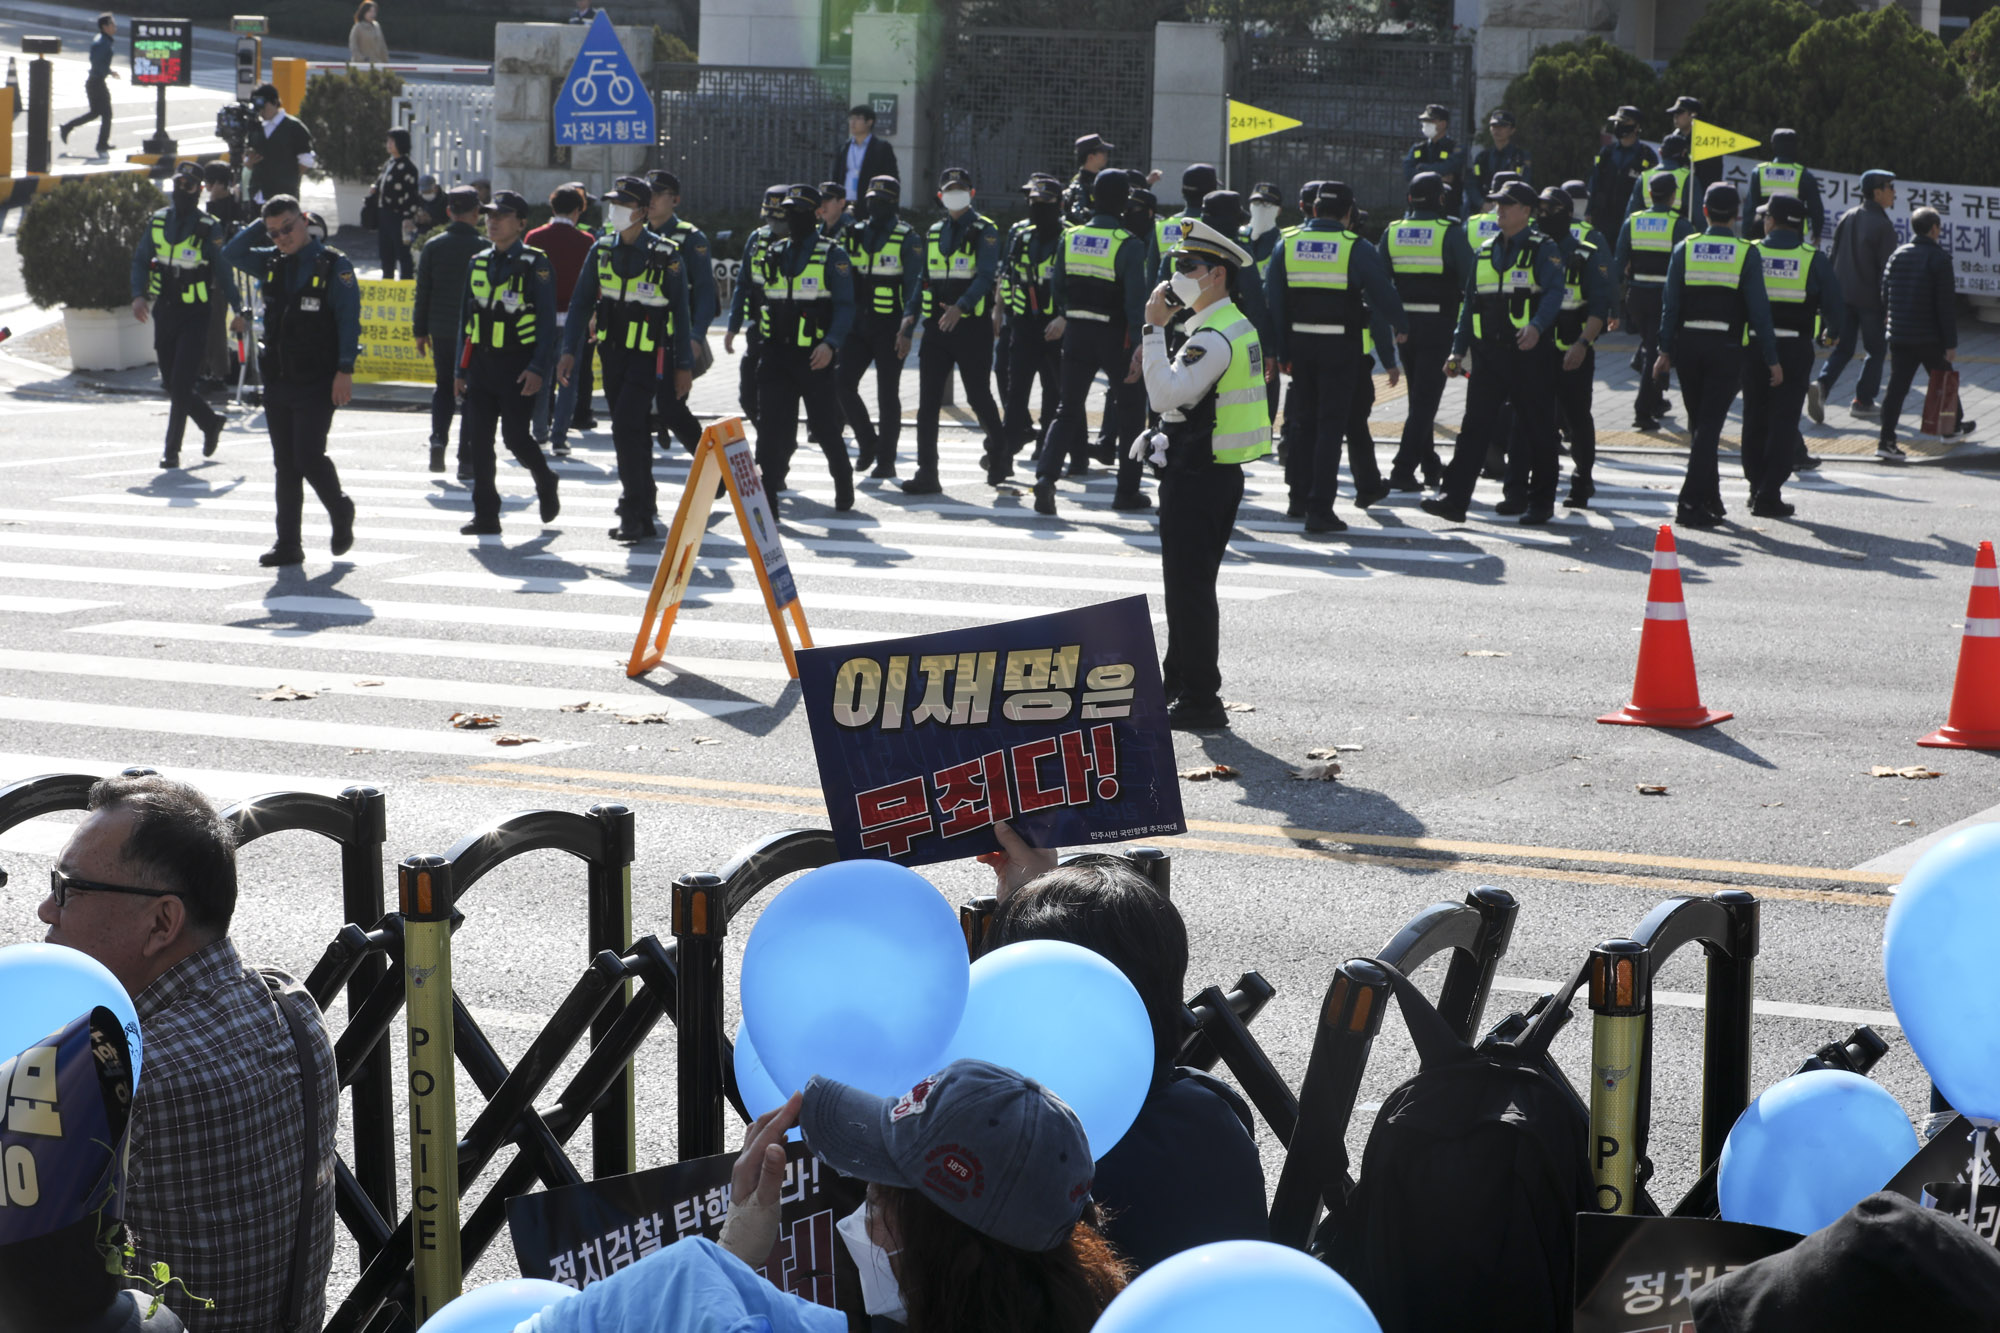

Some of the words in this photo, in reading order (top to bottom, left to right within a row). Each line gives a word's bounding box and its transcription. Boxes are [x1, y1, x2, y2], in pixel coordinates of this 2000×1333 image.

[872, 99, 895, 113] 157
[562, 120, 647, 141] 자전거횡단
[1298, 252, 1333, 261] POLICE
[832, 645, 1136, 729] 이재명은
[855, 723, 1120, 857] 무죄다!
[1090, 831, 1118, 840] 민주시민
[411, 1026, 438, 1250] POLICE
[947, 1159, 968, 1178] 1876
[1623, 1265, 1746, 1315] 정치
